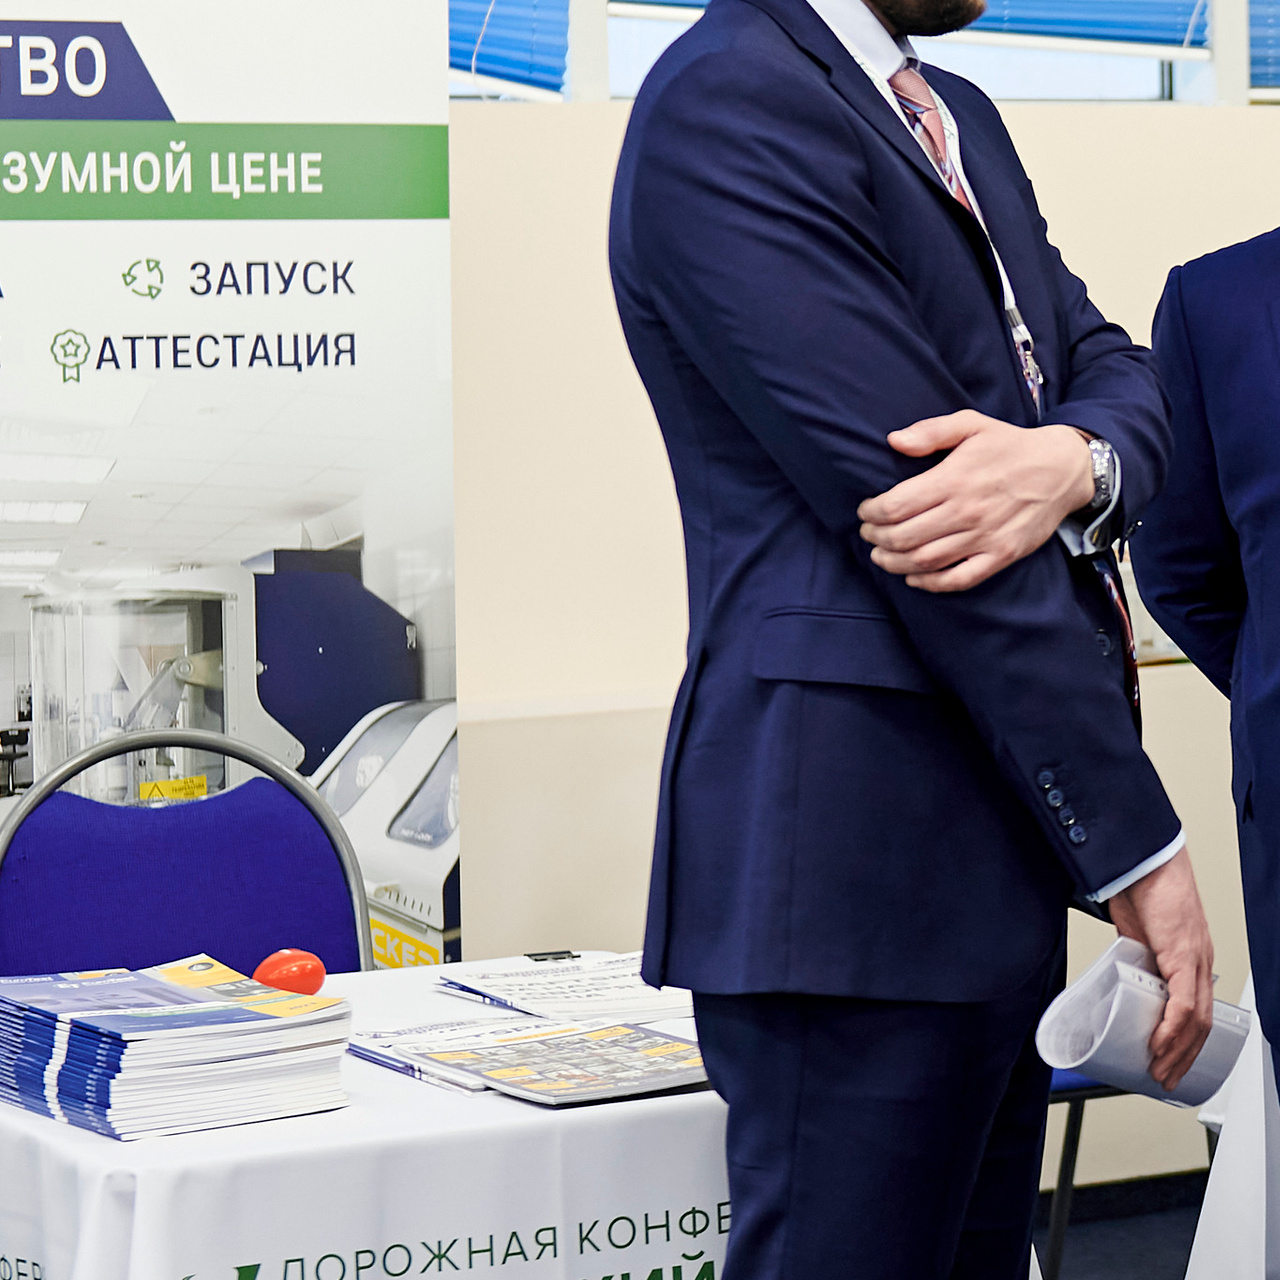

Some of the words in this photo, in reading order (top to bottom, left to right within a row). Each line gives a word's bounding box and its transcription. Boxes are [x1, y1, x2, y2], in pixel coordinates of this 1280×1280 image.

[3, 141, 192, 194] ЗУМНОЙ
[210, 151, 323, 199] ЦЕНЕ
[189, 260, 356, 296] ЗАПУСК
[96, 332, 356, 372] АТТЕСТАЦИЯ
